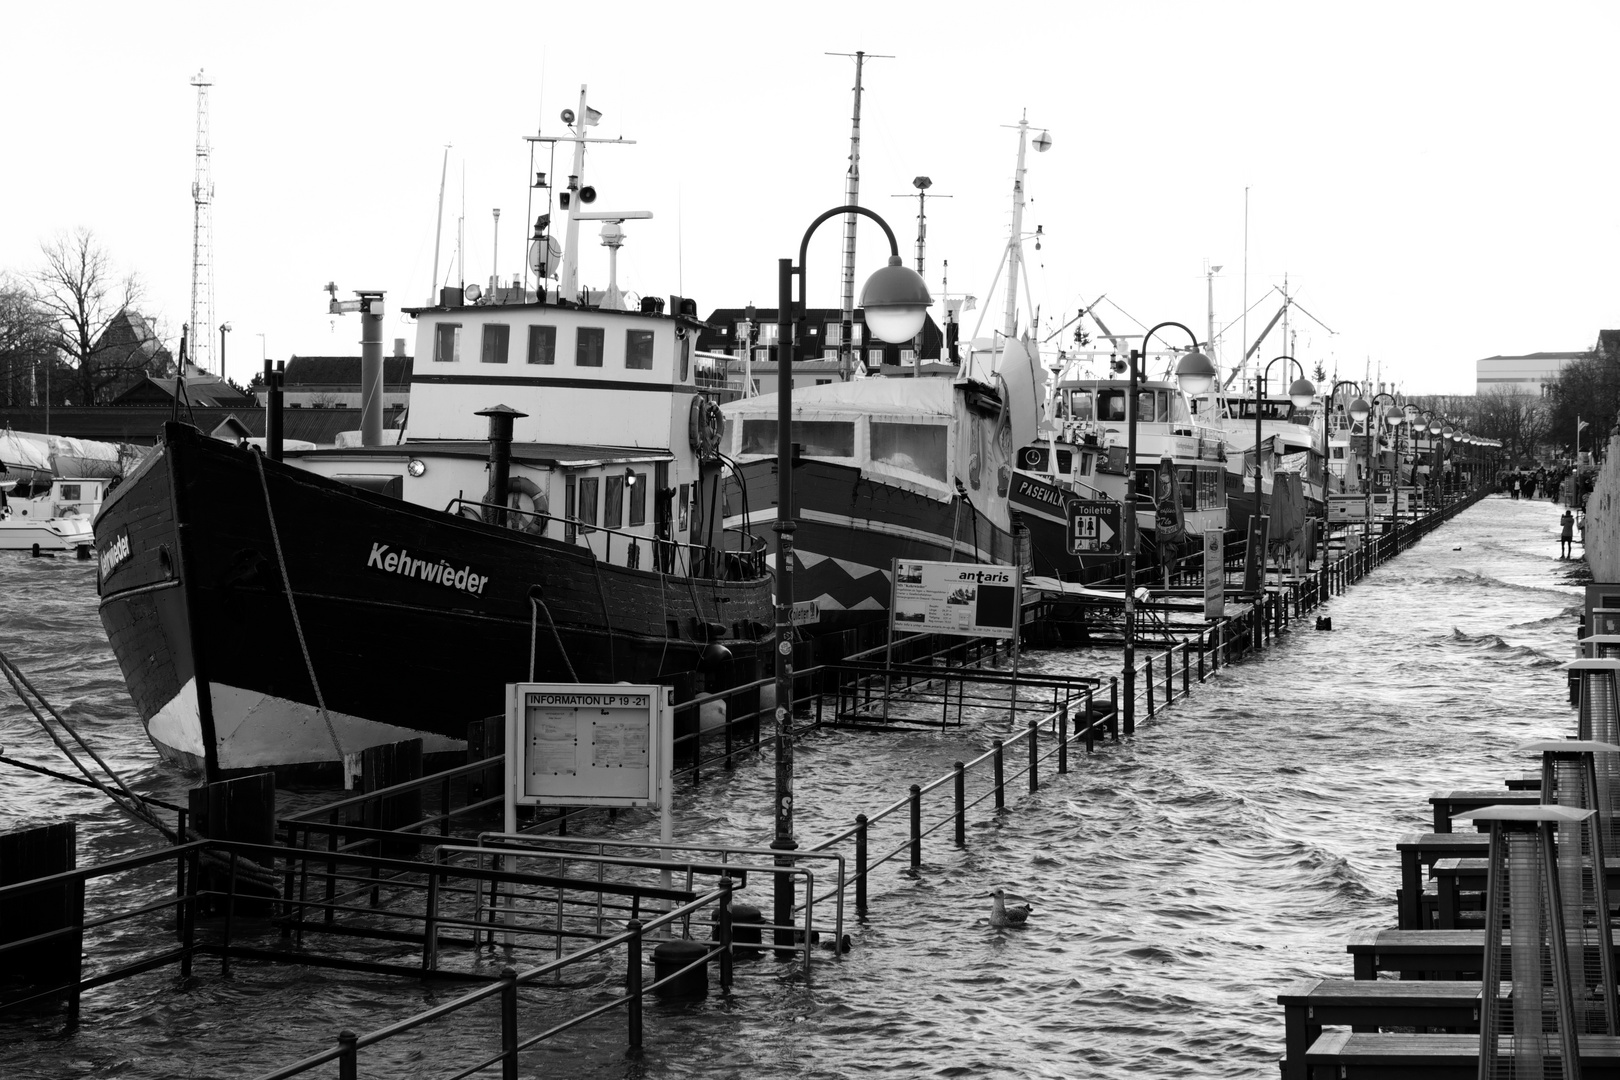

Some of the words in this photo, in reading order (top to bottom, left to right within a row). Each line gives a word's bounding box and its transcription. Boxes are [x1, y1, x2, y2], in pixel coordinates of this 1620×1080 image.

[1018, 481, 1065, 507] PASEWALK
[1079, 505, 1112, 515] Toilette
[367, 542, 489, 594] Kehrwieder
[958, 570, 1009, 584] antaris
[530, 695, 601, 705] INFORMATION
[603, 696, 616, 705] LP
[618, 696, 630, 706] 19
